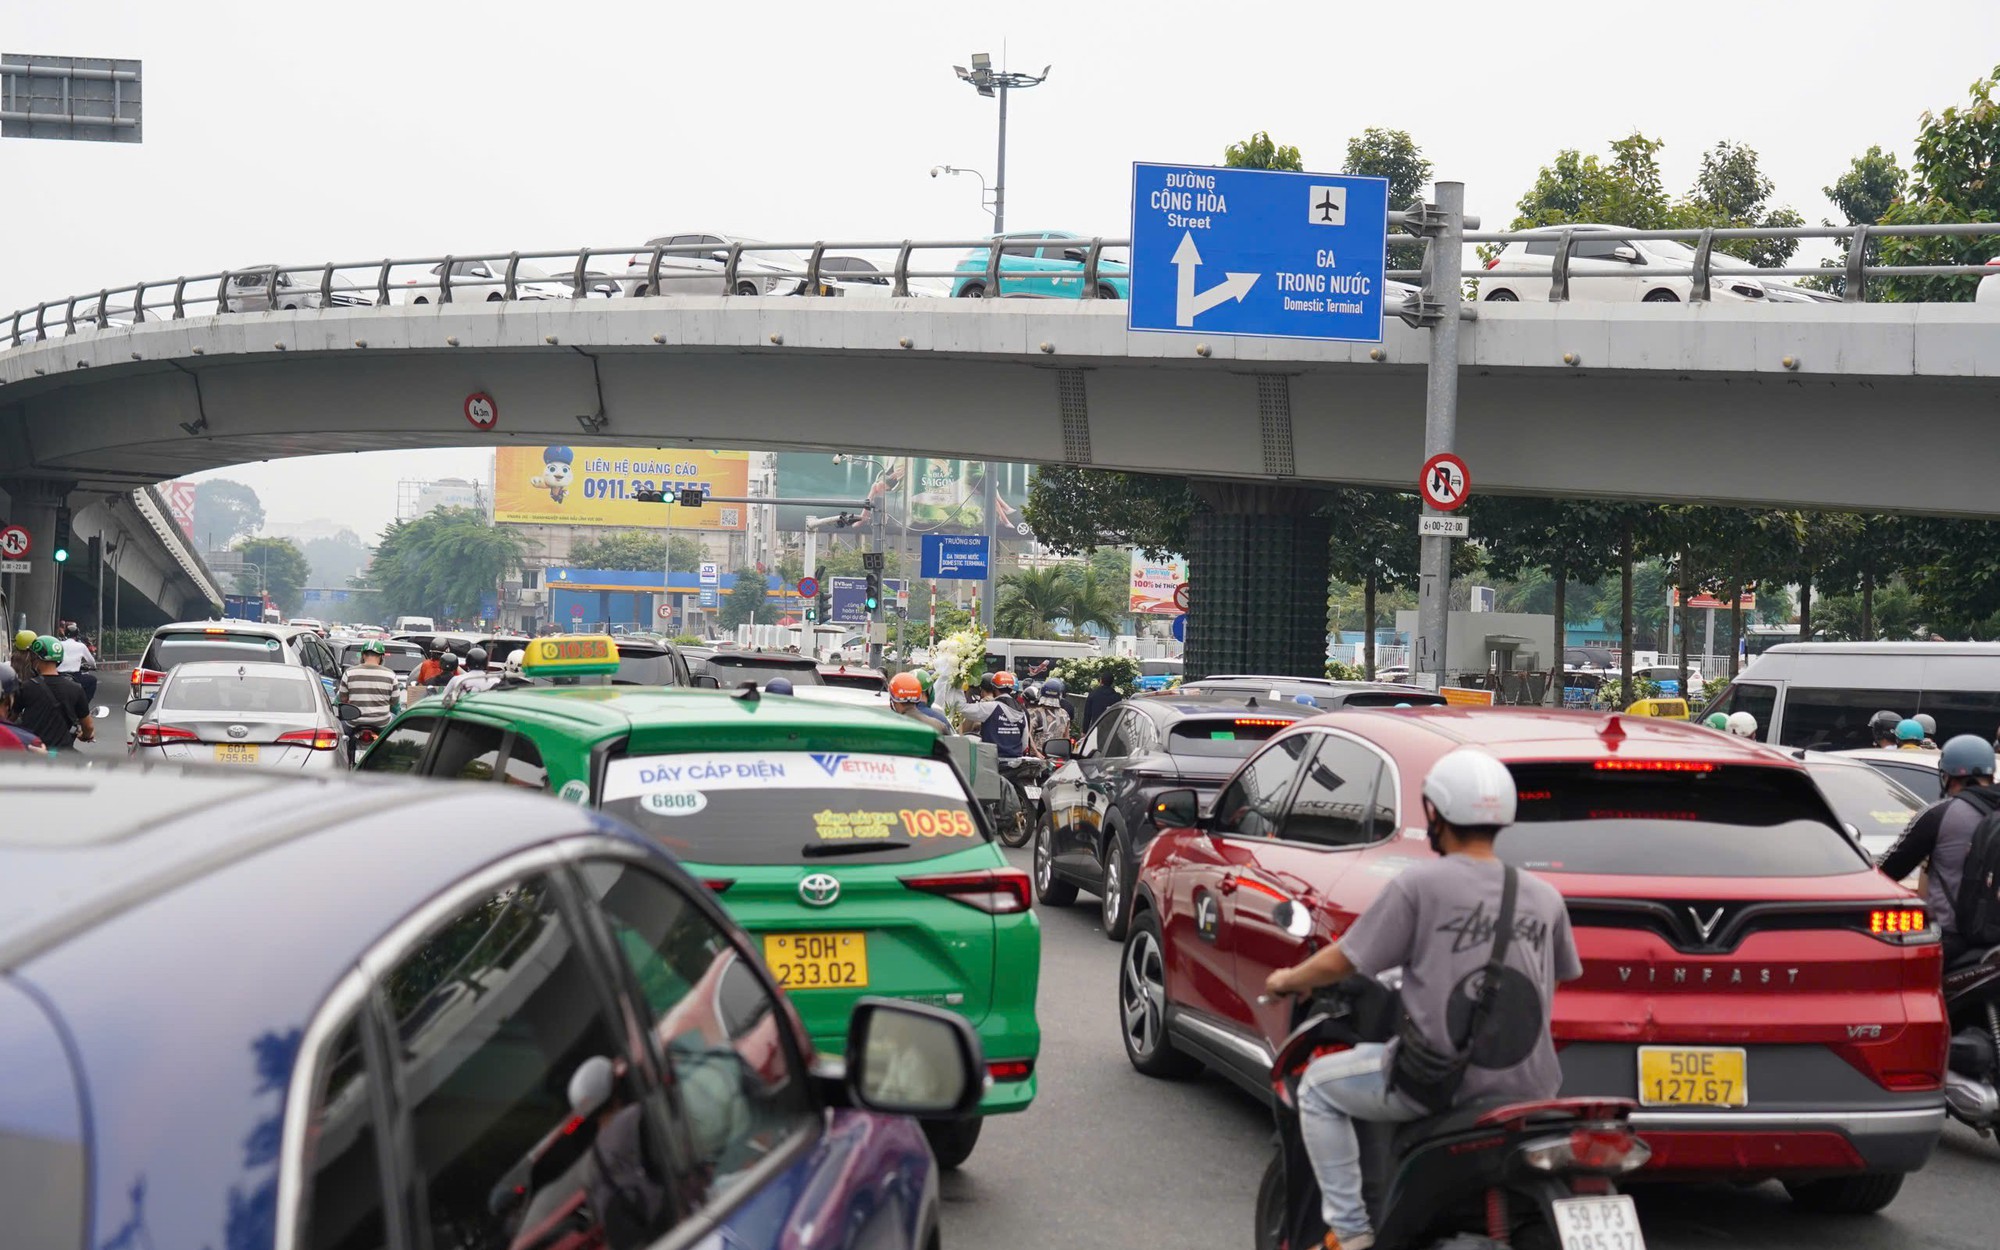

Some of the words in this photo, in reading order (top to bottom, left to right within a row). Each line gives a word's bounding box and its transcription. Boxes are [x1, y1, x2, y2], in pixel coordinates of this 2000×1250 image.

[1166, 171, 1215, 189] ĐƯỜNG
[1151, 189, 1193, 212] CỘNG
[1197, 191, 1227, 213] HÒA
[1168, 213, 1211, 229] Street
[1316, 250, 1336, 268] GA
[1276, 272, 1326, 295] TRONG
[1330, 272, 1371, 296] NƯỚC
[1284, 297, 1324, 313] Domestic
[1326, 299, 1363, 315] Terminal
[585, 458, 610, 472] LIÊN
[614, 459, 629, 476] HỆ
[633, 460, 671, 475] QUẢNG
[675, 461, 697, 476] CÁO
[921, 476, 955, 487] SAIGON
[558, 641, 606, 658] 1055
[219, 753, 254, 763] 795.85
[640, 764, 681, 784] DÂY
[688, 761, 732, 779] CÁP
[736, 760, 786, 782] ĐIỆN
[652, 794, 697, 808] 6808
[901, 810, 973, 837] 1055
[794, 937, 837, 958] 50H
[779, 963, 856, 985] 233.02
[1618, 967, 1799, 983] VINFAST
[1670, 1053, 1714, 1076] 50E
[1655, 1079, 1734, 1102] 127.67
